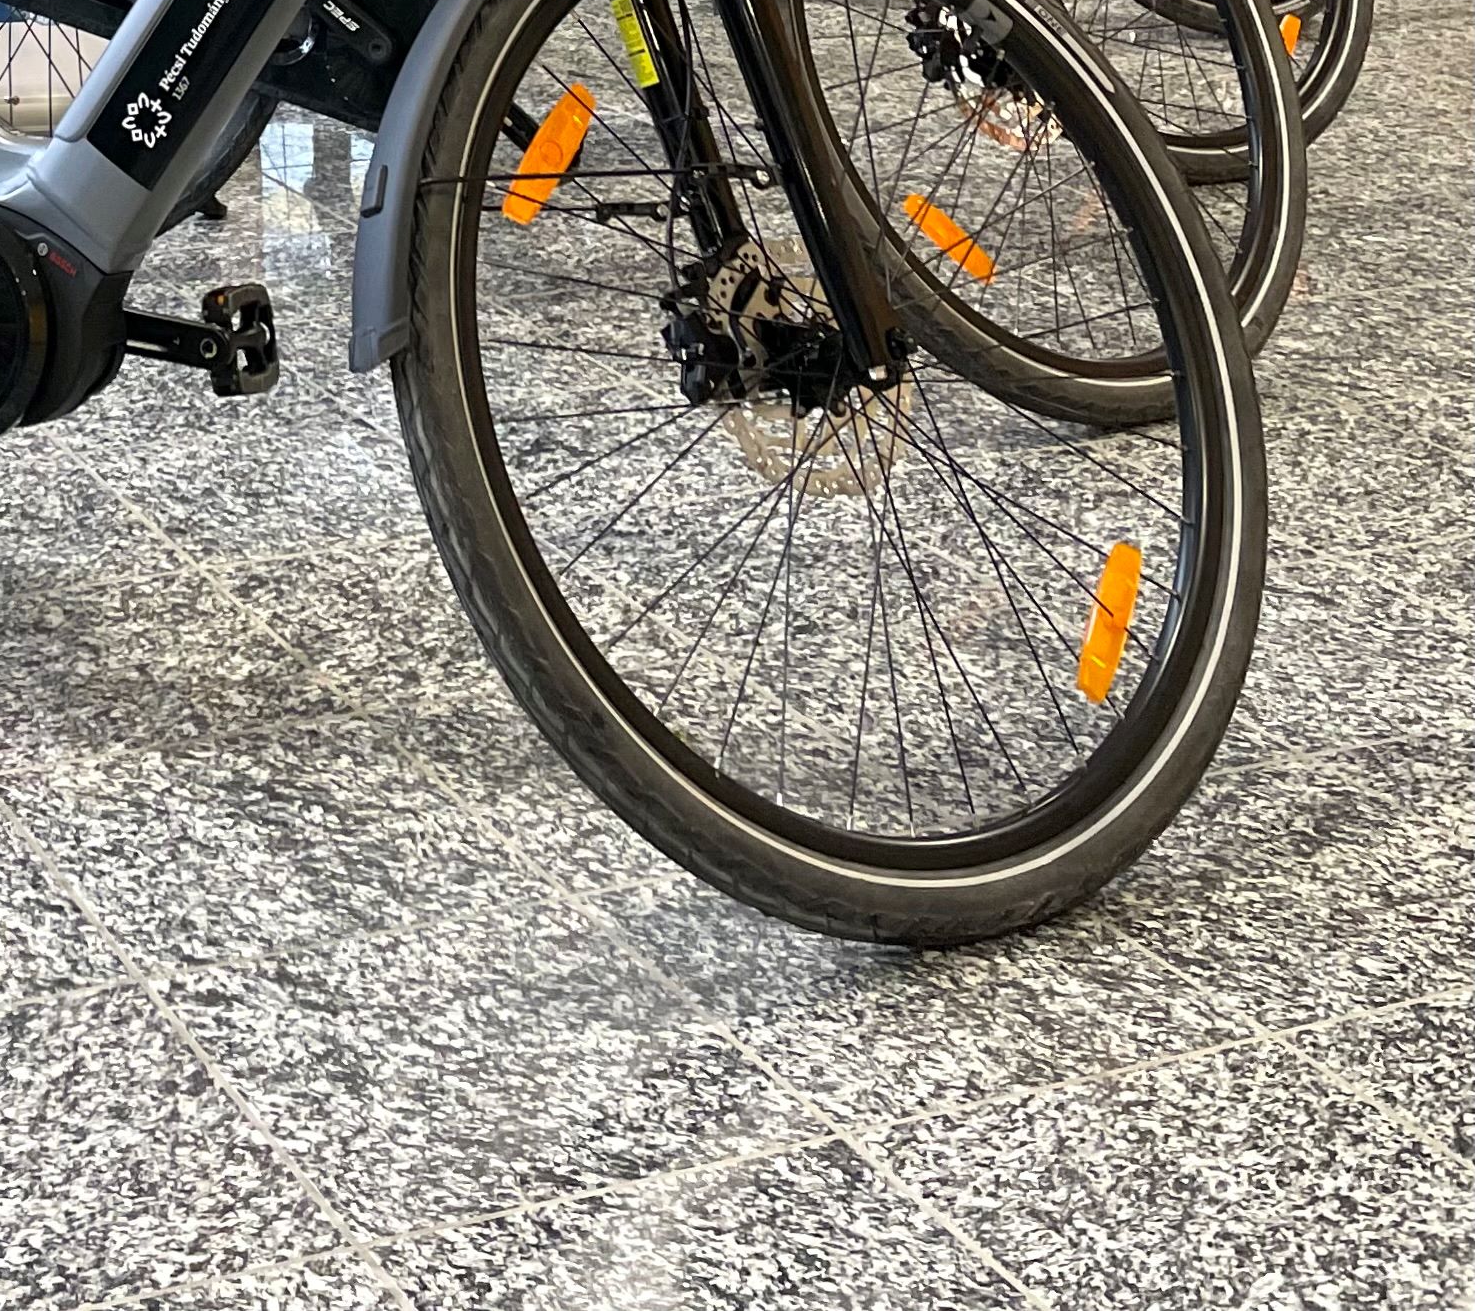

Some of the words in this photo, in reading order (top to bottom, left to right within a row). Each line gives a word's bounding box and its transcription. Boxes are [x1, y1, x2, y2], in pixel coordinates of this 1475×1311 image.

[323, 0, 360, 32] SPEC
[158, 54, 186, 92] Pécsi
[172, 75, 191, 101] 1367
